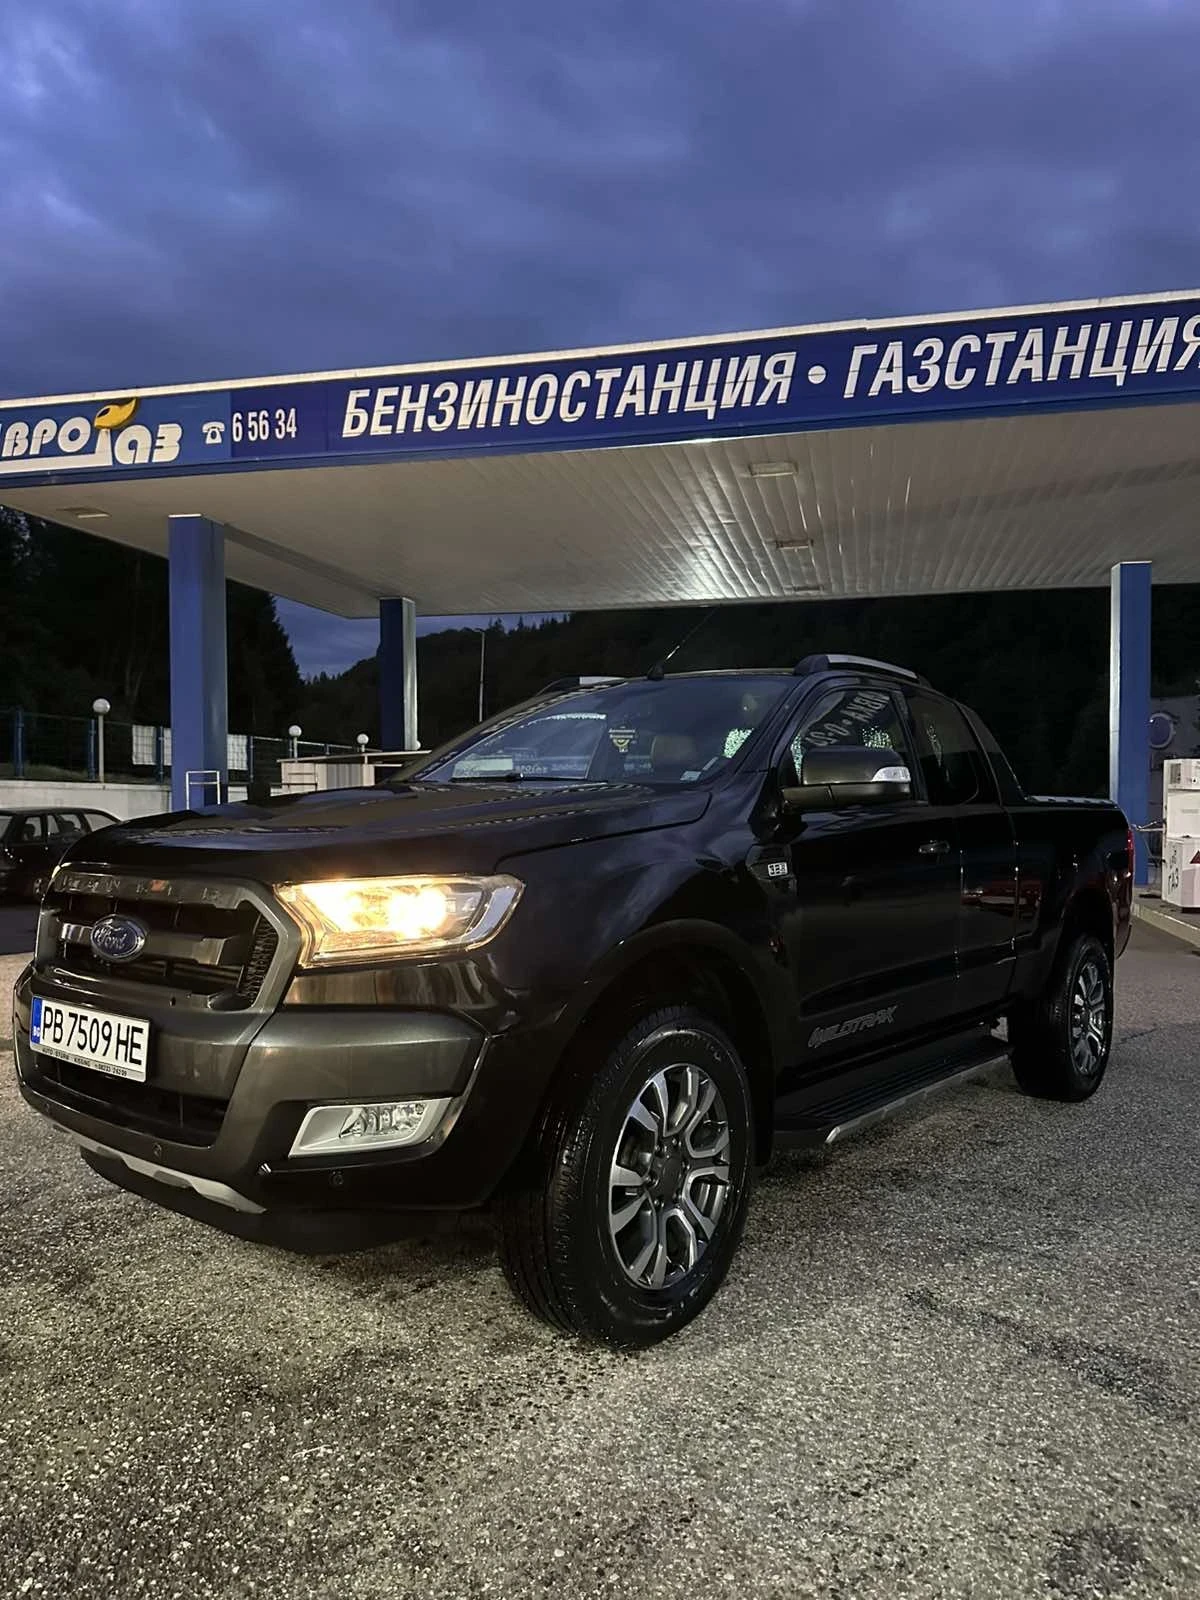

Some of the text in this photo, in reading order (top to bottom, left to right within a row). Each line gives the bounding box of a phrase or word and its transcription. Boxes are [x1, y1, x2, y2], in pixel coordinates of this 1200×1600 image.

[342, 351, 797, 438] БЕНЗИНОСТАНЦИЯ
[232, 407, 297, 442] 6 56 34
[95, 925, 129, 951] Ford
[42, 1006, 144, 1066] PB 7509 HE
[807, 1005, 898, 1049] WILDTRAK
